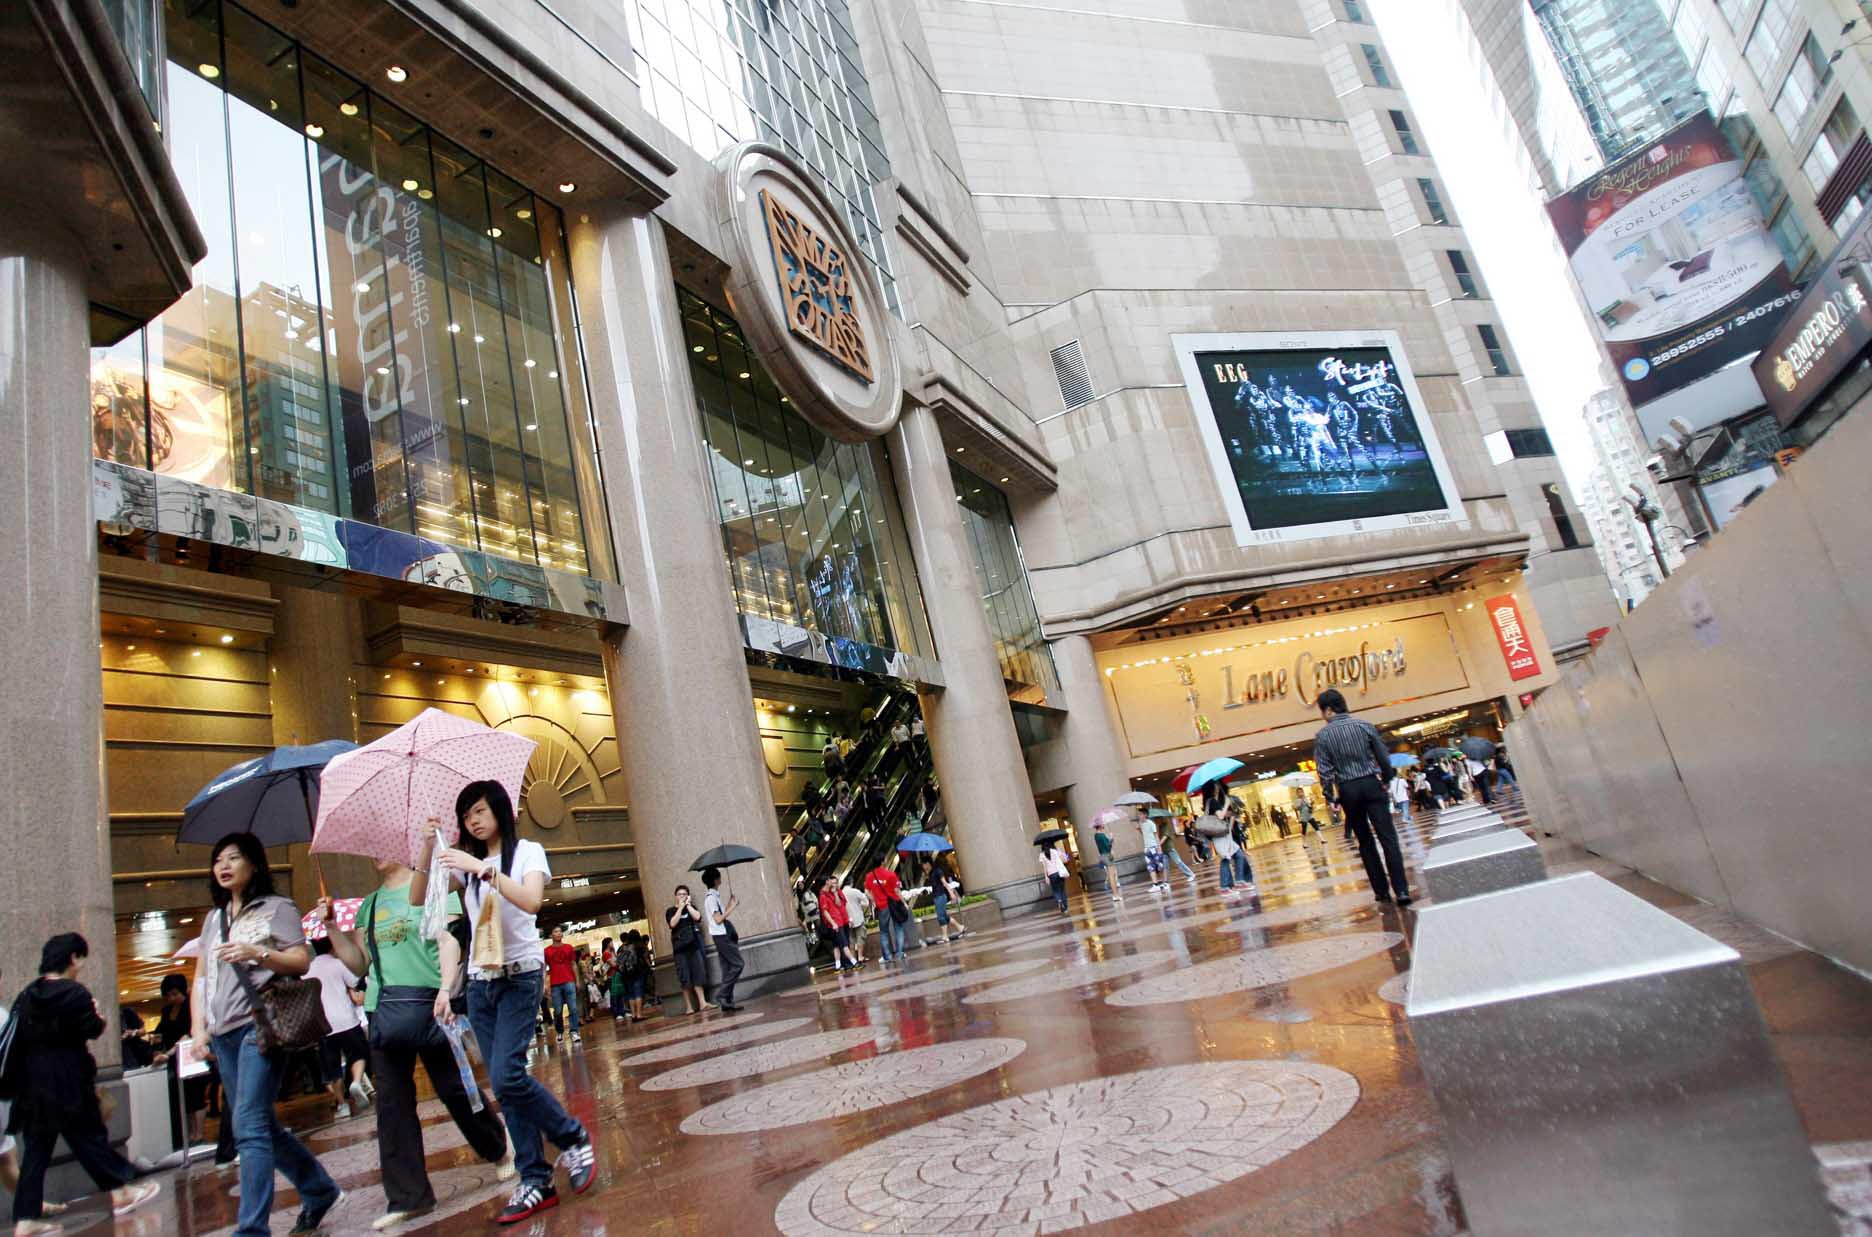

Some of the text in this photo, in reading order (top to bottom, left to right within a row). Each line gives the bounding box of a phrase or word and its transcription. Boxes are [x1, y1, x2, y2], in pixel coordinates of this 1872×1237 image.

[1614, 215, 1645, 238] FOR
[1648, 186, 1699, 218] LEASE
[1652, 325, 1726, 367] 28952555
[1786, 290, 1850, 371] EMPEROR
[1213, 363, 1249, 383] EEG
[1221, 636, 1406, 710] Lane Crawford
